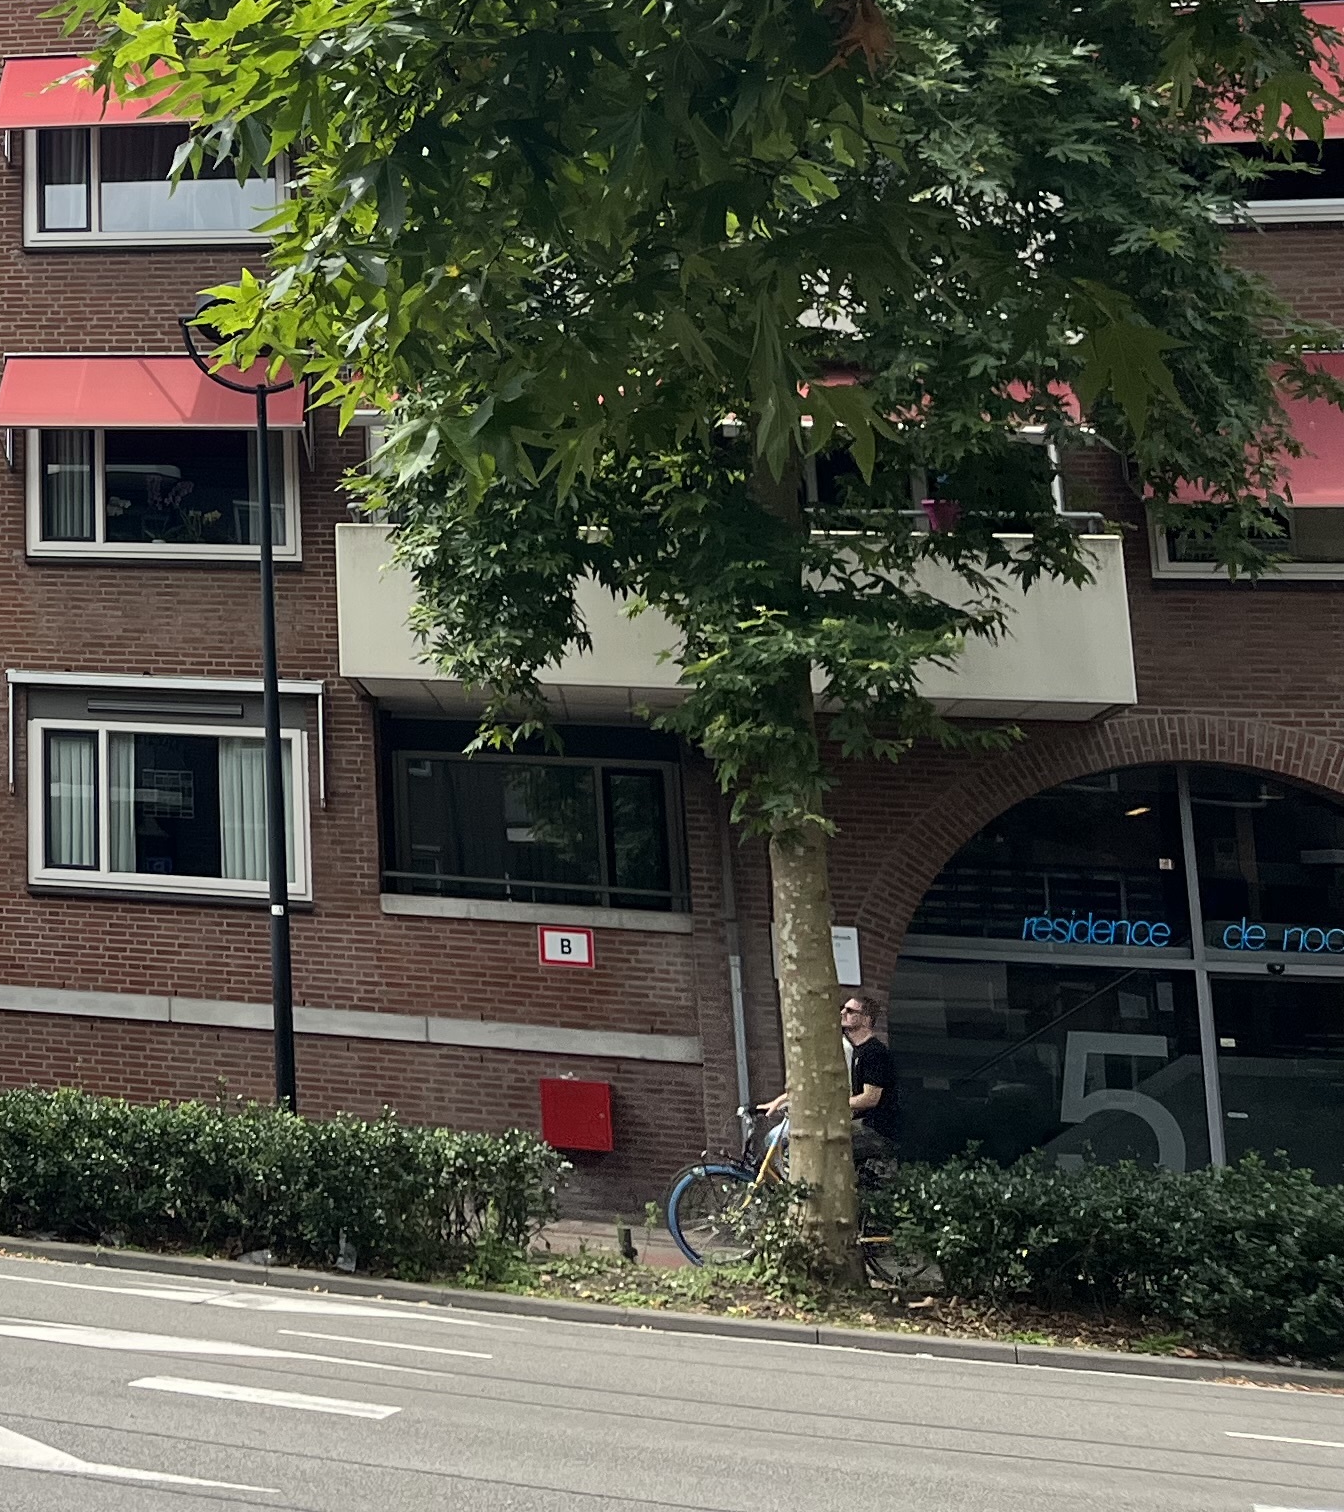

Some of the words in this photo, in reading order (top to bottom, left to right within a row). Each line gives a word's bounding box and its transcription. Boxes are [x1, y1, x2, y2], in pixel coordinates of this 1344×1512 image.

[560, 937, 572, 955] B
[1223, 916, 1267, 950] de
[1060, 1031, 1187, 1175] 5
